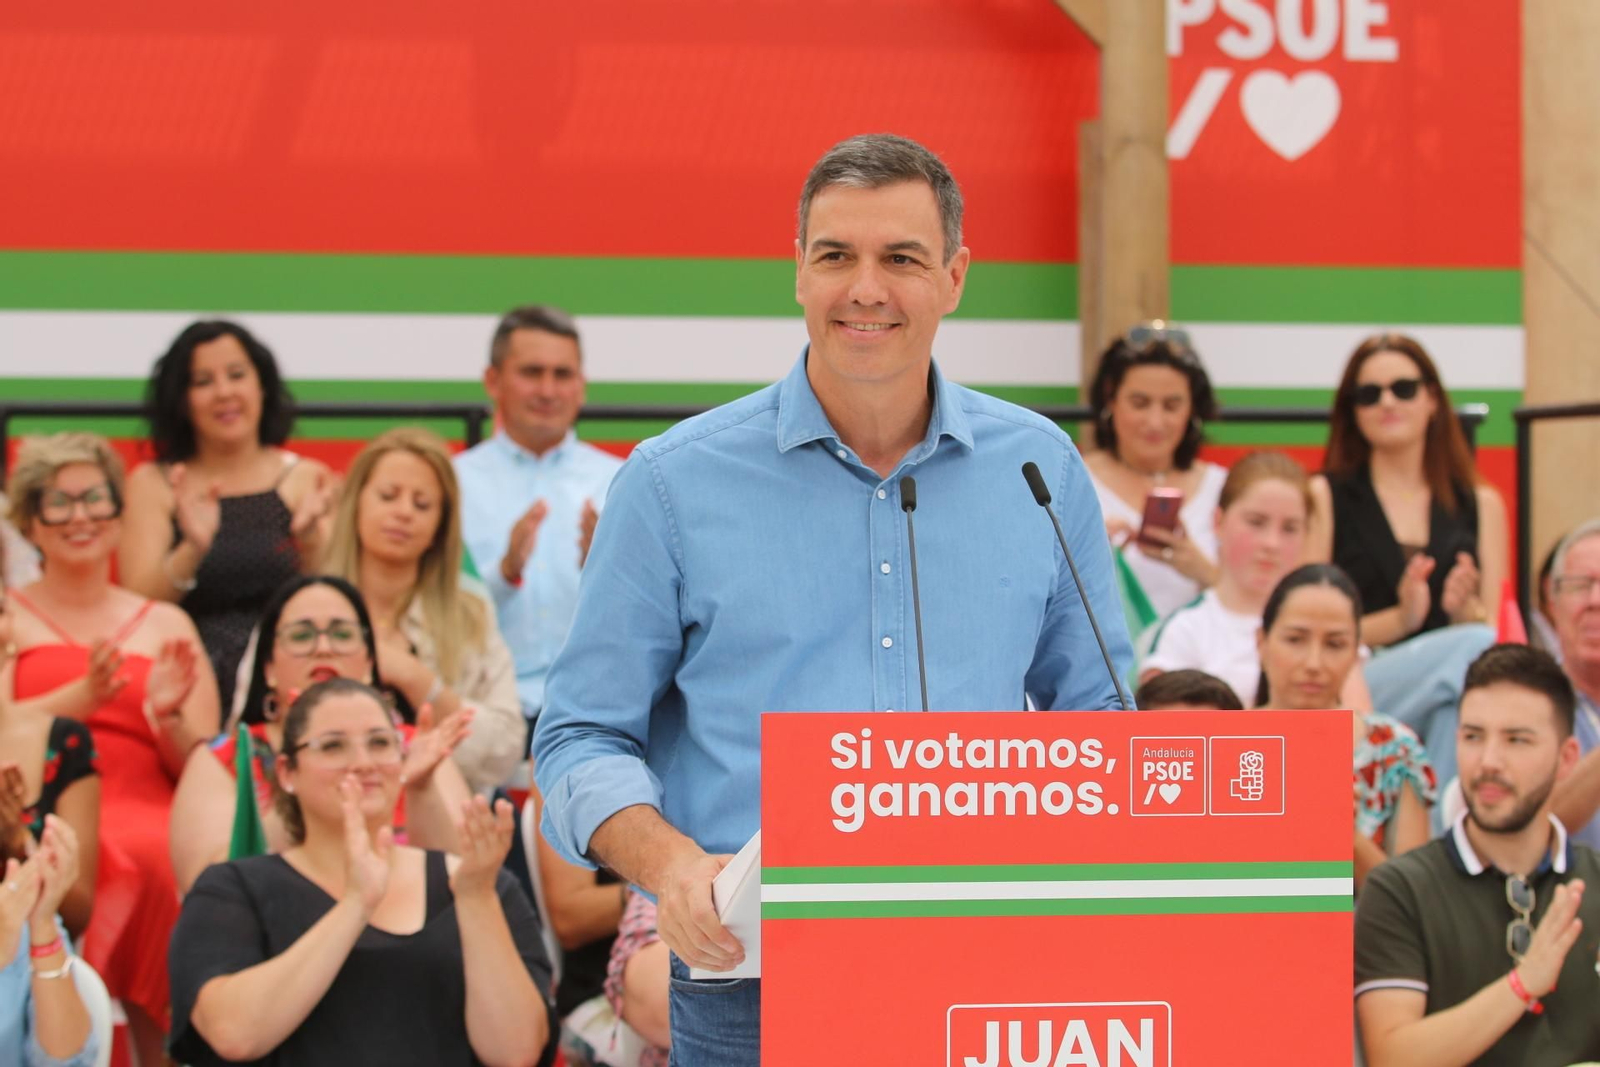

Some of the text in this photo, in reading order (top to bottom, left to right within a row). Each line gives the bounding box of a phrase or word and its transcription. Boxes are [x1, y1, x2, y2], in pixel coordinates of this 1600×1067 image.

[831, 728, 1117, 774] Si votamos,
[1142, 747, 1194, 759] Andalucía
[1142, 761, 1194, 781] PSOE
[831, 779, 1119, 832] ganamos.
[963, 1018, 1154, 1067] JUAN
